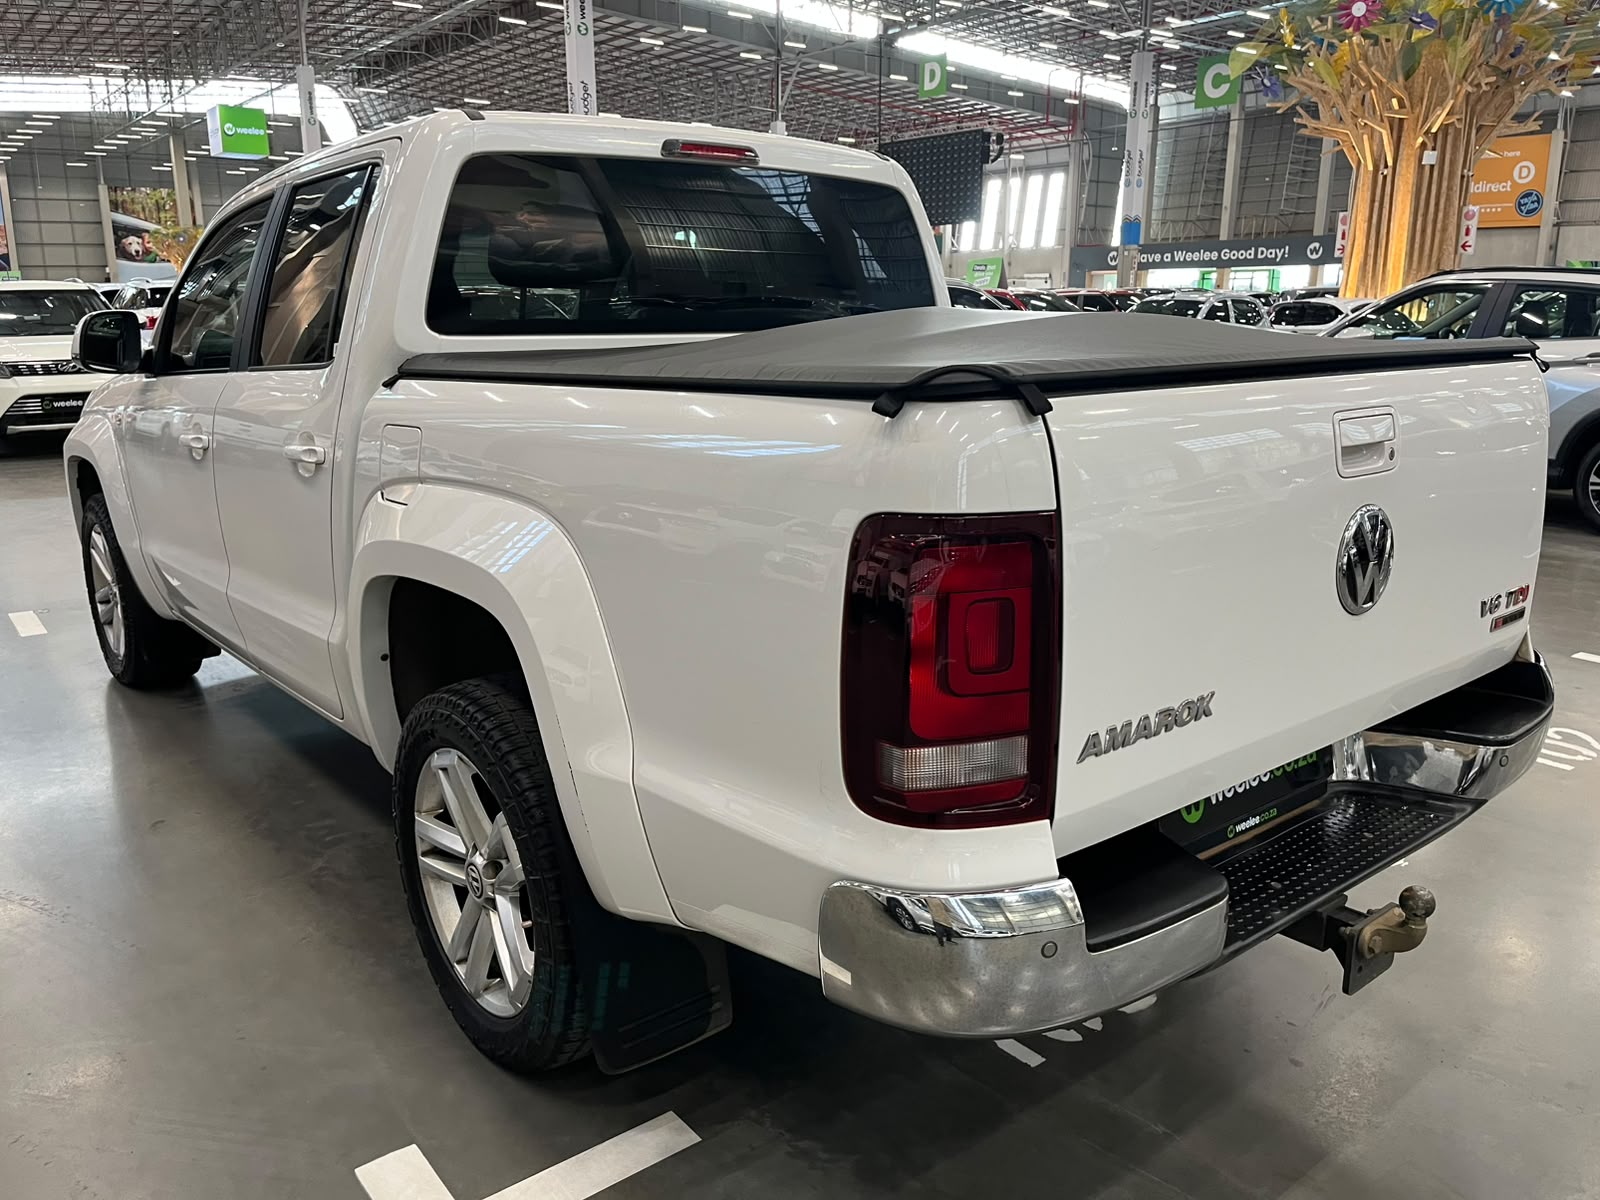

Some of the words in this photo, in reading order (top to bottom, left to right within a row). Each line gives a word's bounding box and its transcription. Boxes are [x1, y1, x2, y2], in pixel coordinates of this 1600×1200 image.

[923, 62, 942, 91] D
[1203, 62, 1232, 99] C
[580, 80, 592, 115] udget
[235, 127, 265, 135] weelee
[1163, 252, 1171, 262] a
[1174, 249, 1218, 262] Weelee
[1220, 247, 1255, 260] Good
[1257, 245, 1289, 262] Day!
[53, 399, 84, 408] weelee
[1480, 593, 1502, 618] V6
[1505, 584, 1530, 609] TDI
[1076, 690, 1215, 764] AMAROK
[1235, 808, 1278, 832] weelee.co.za
